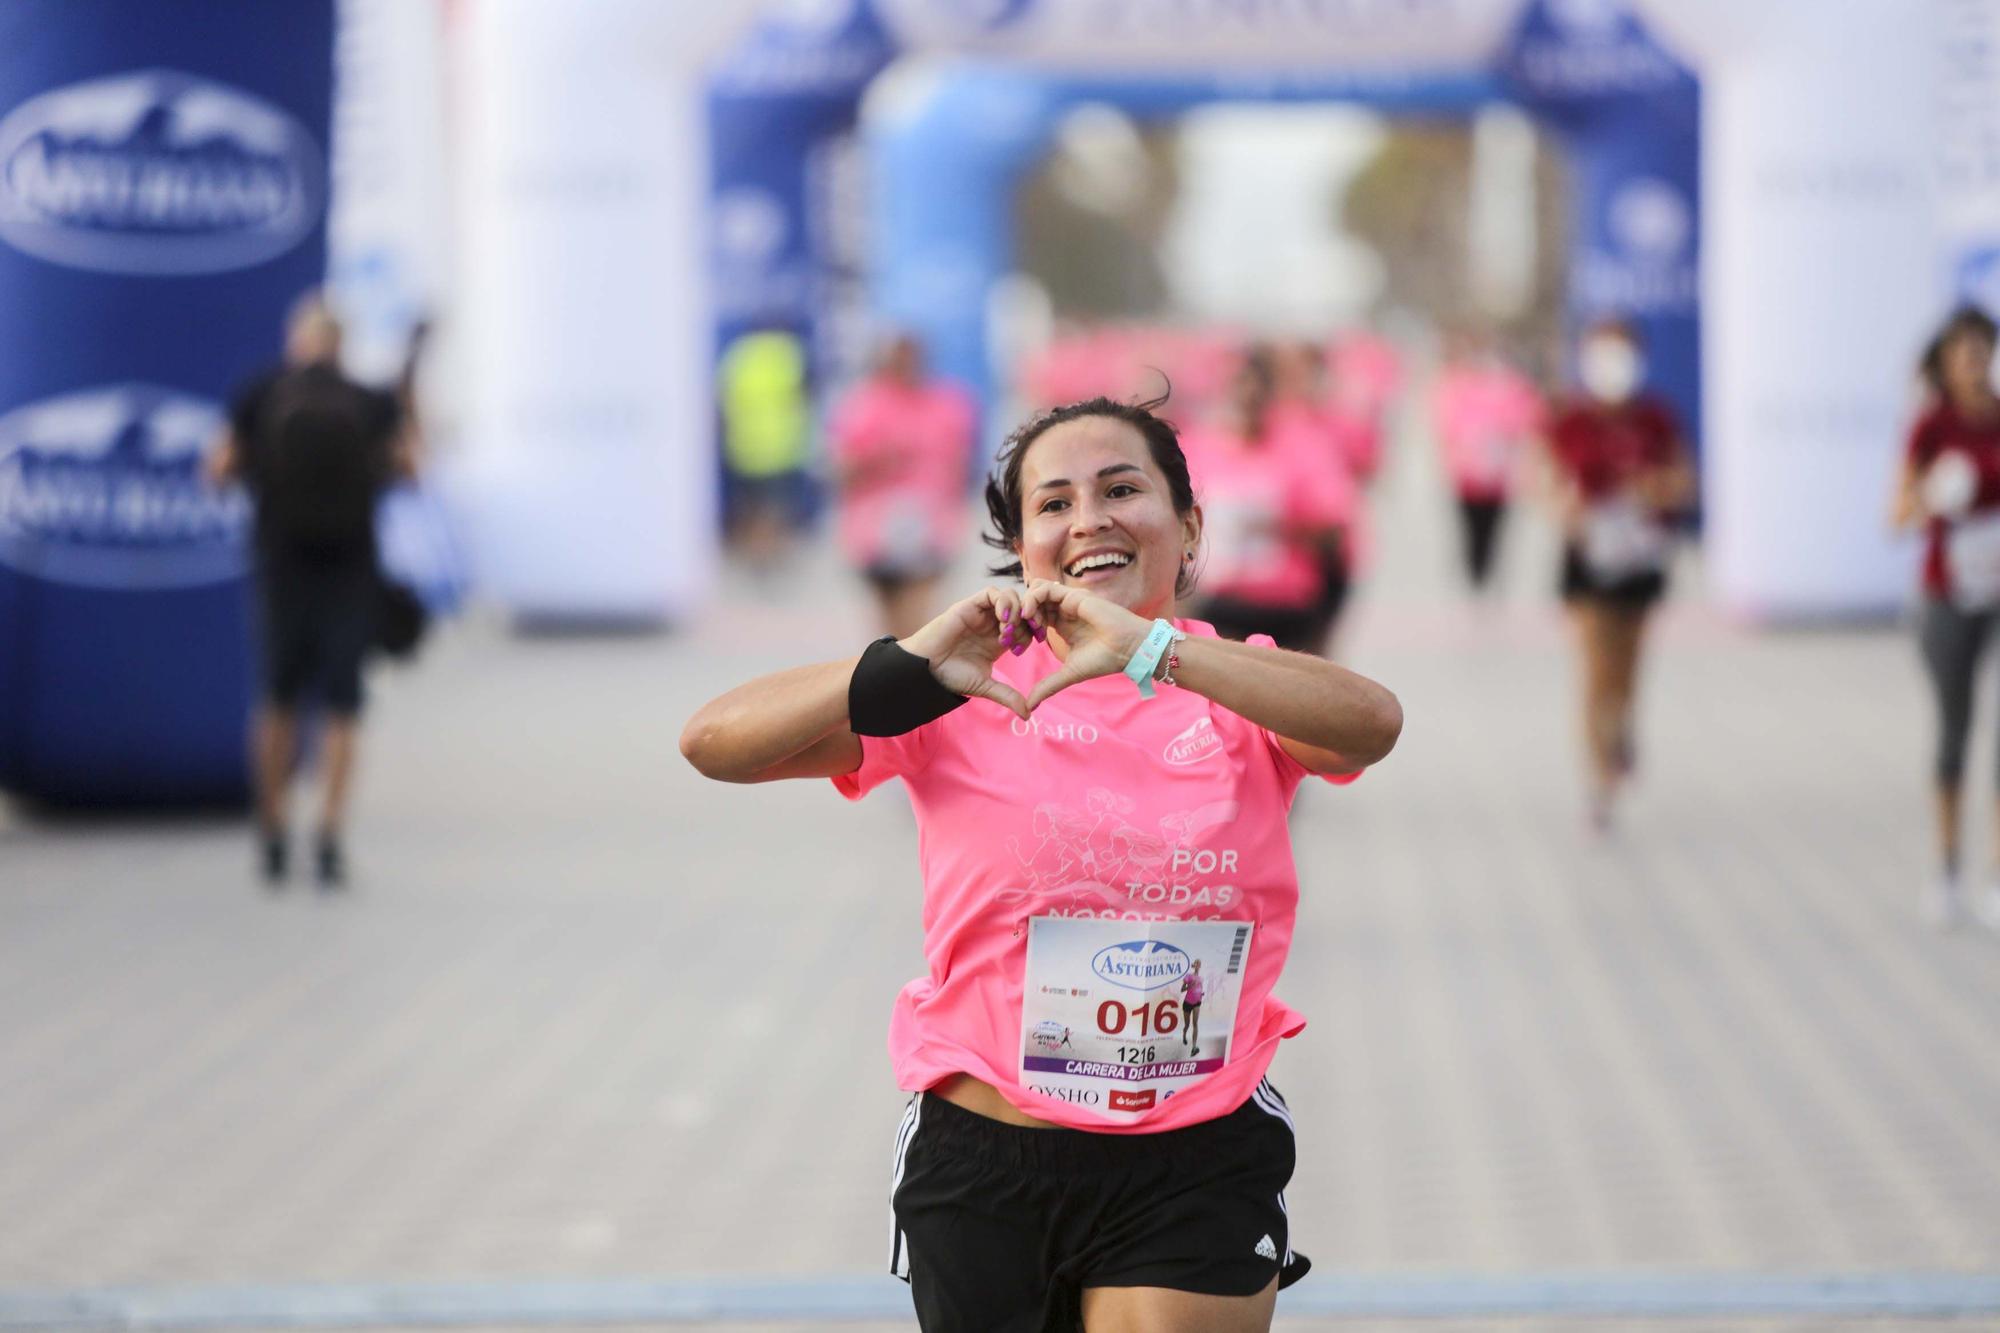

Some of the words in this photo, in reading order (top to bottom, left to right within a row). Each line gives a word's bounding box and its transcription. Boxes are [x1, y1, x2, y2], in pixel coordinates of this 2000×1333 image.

[1171, 732, 1219, 762] ASTURIA
[1172, 850, 1238, 873] POR
[1125, 882, 1233, 907] TODAS
[1100, 955, 1182, 977] ASTURIANA
[1097, 1000, 1179, 1037] 016
[1117, 1046, 1156, 1064] 1216
[1065, 1061, 1125, 1079] CARRERA
[1128, 1067, 1144, 1081] DE
[1144, 1065, 1158, 1079] LA
[1158, 1062, 1197, 1077] MUJER
